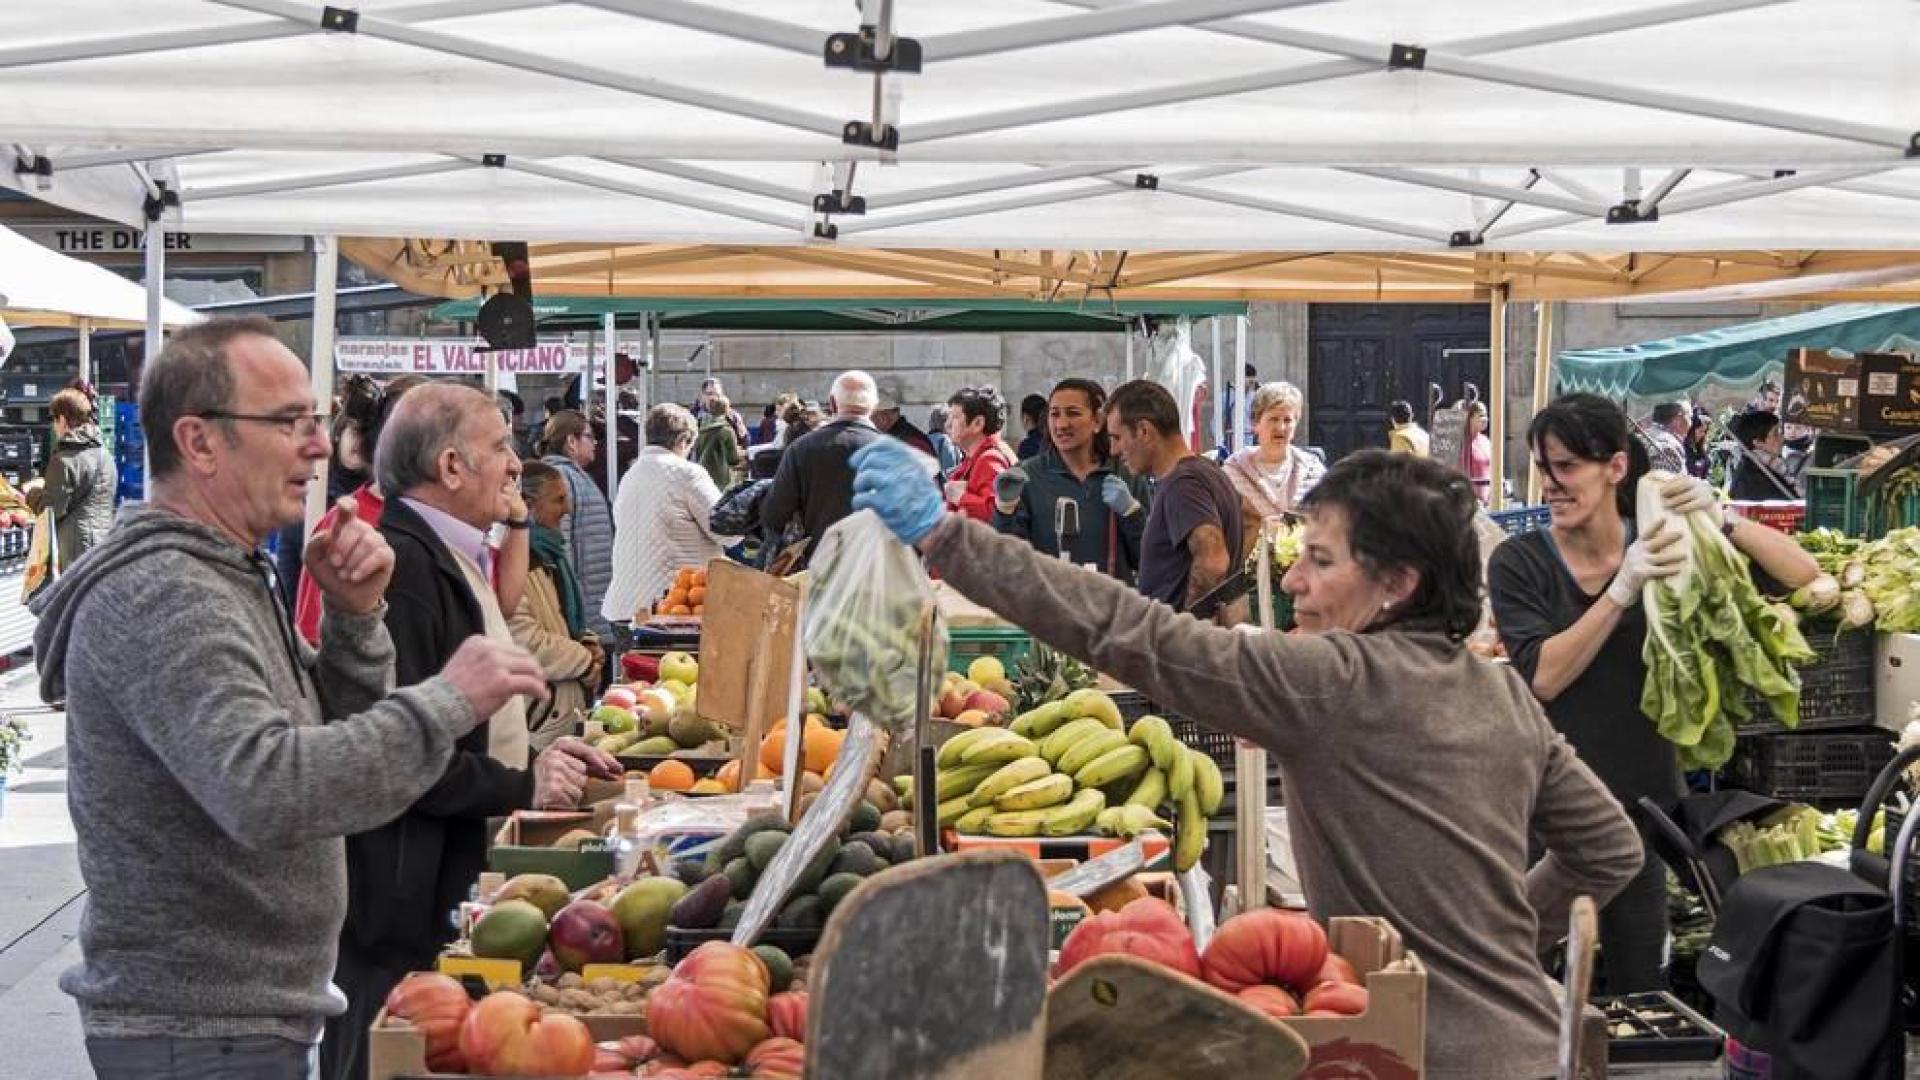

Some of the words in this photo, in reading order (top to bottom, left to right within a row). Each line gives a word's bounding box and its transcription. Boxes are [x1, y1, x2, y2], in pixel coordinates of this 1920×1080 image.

[56, 231, 103, 249] THE
[113, 231, 191, 249] DIER
[413, 344, 436, 370] EL
